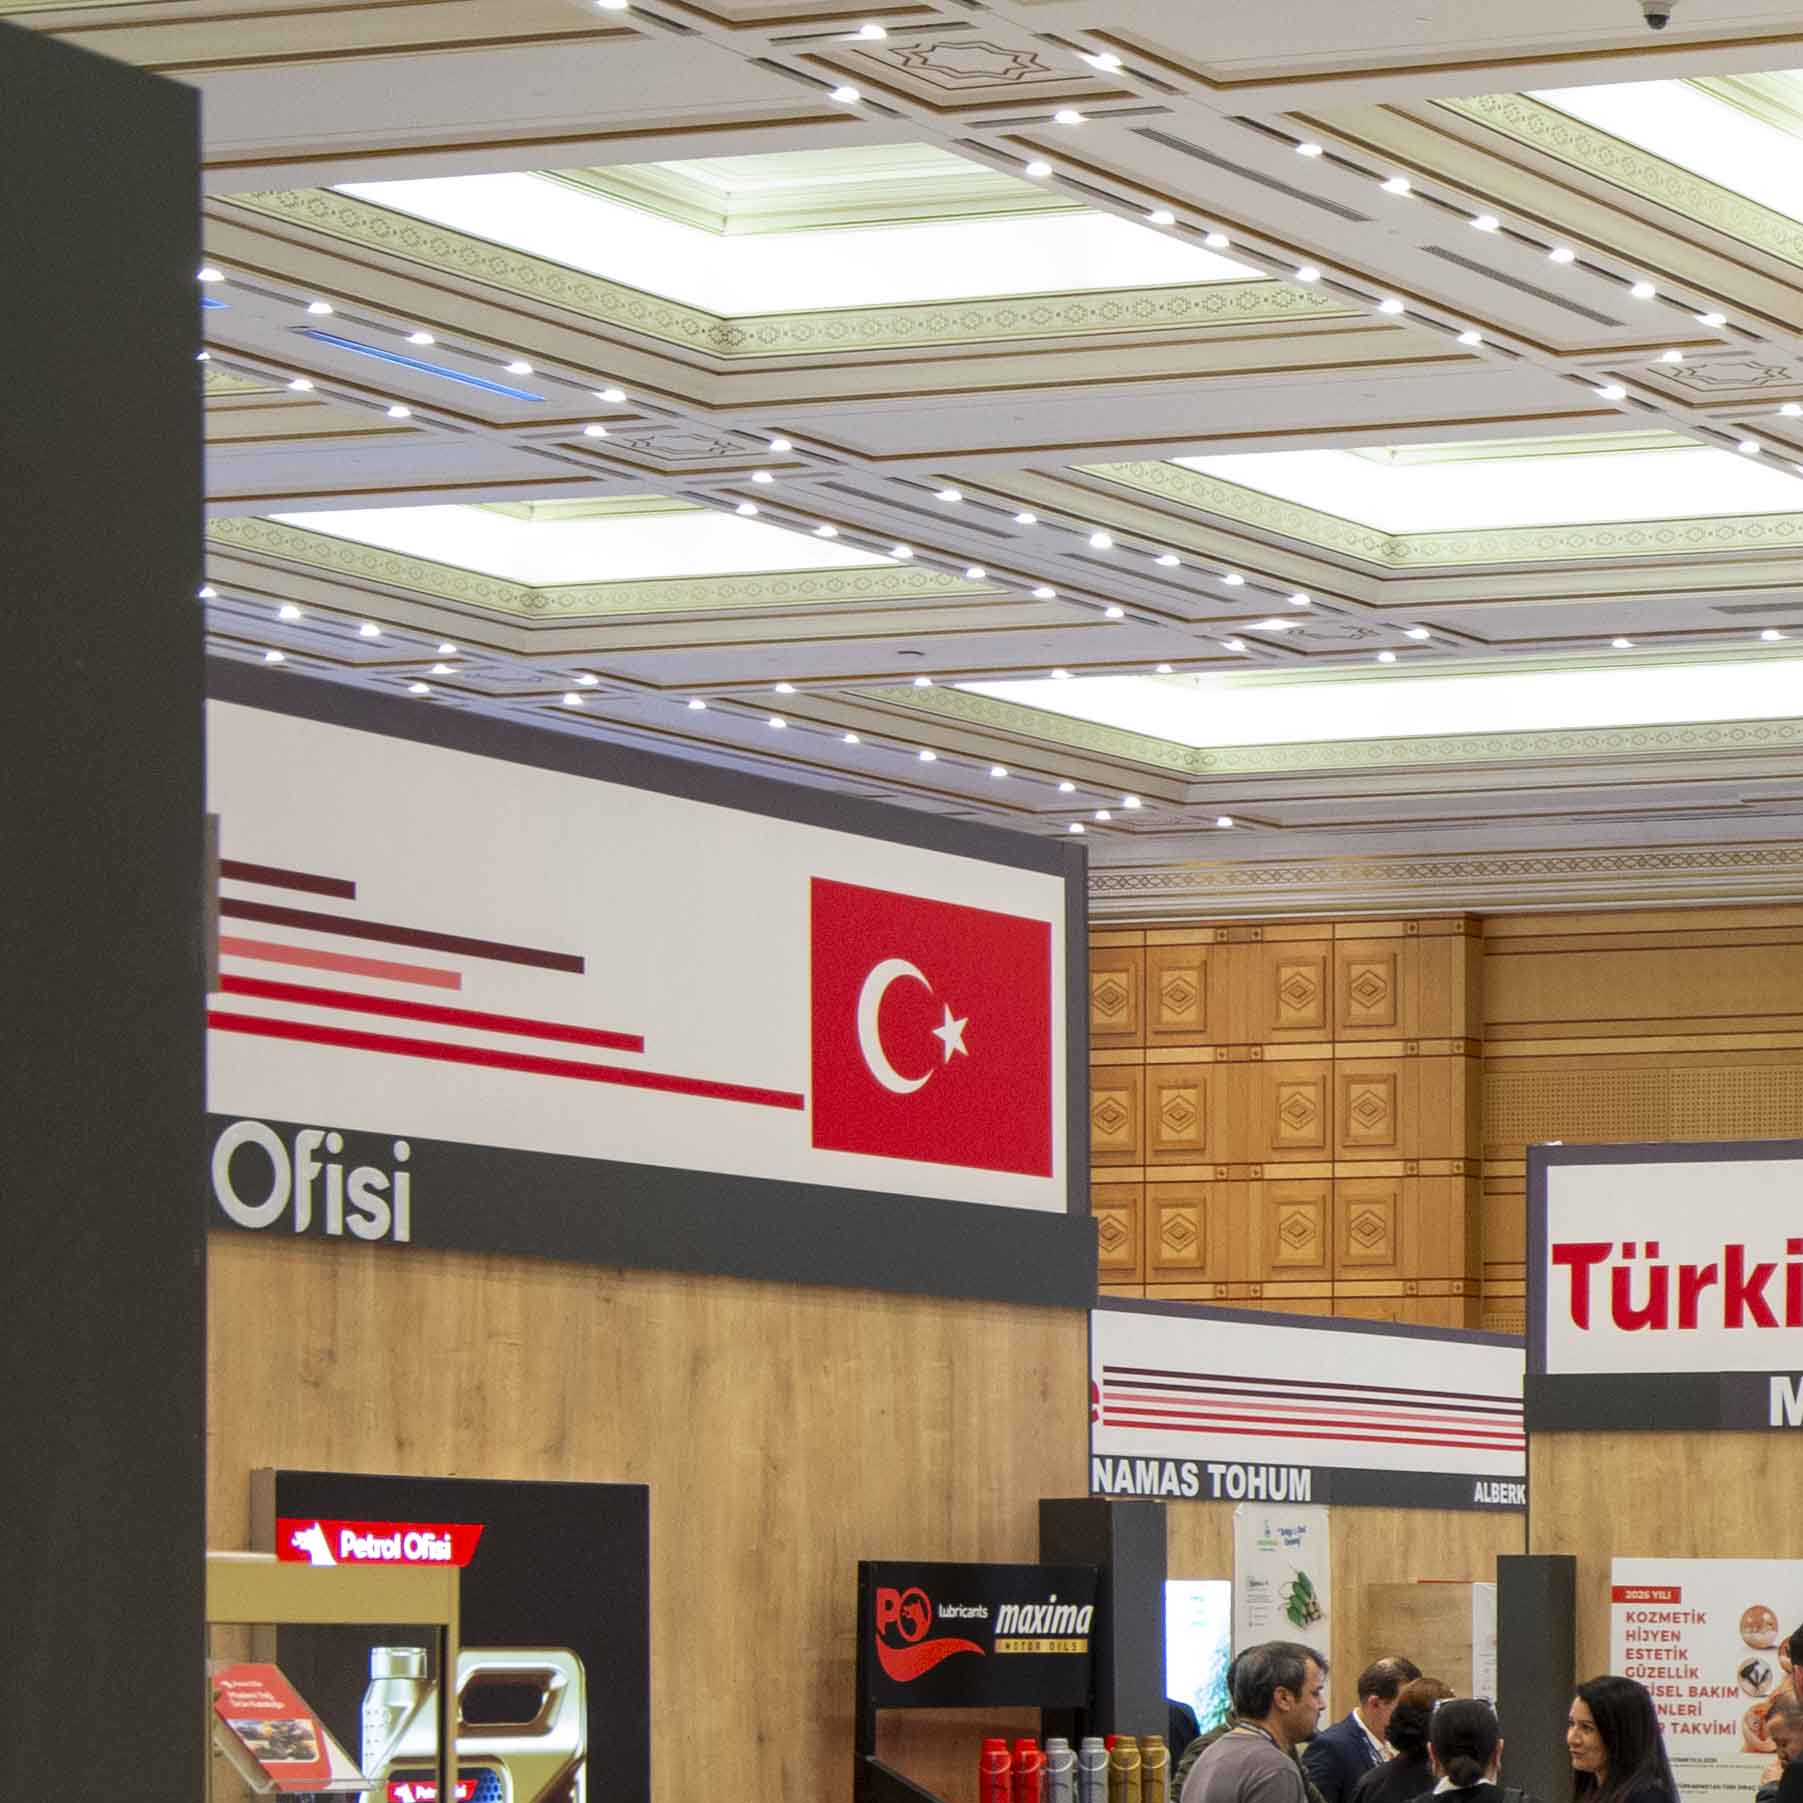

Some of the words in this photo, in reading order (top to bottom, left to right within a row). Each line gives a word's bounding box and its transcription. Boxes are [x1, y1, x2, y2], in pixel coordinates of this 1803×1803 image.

[211, 1120, 411, 1243] Ofisi
[1092, 1458, 1200, 1498] NAMAS
[1207, 1464, 1312, 1502] TOHUM
[1473, 1480, 1527, 1505] ALBERK
[340, 1529, 401, 1560] Petrol
[405, 1532, 451, 1562] Ofisi
[938, 1603, 988, 1619] lubricants
[994, 1594, 1095, 1635] maxima
[1625, 1609, 1706, 1624] KOZMETİK
[1625, 1628, 1681, 1643] HİJYEN
[1625, 1646, 1688, 1661] ESTETİK
[1625, 1664, 1699, 1680] GÜZELLİK
[1688, 1685, 1739, 1698] BAKIM
[1671, 1720, 1736, 1736] TAKVİMİ
